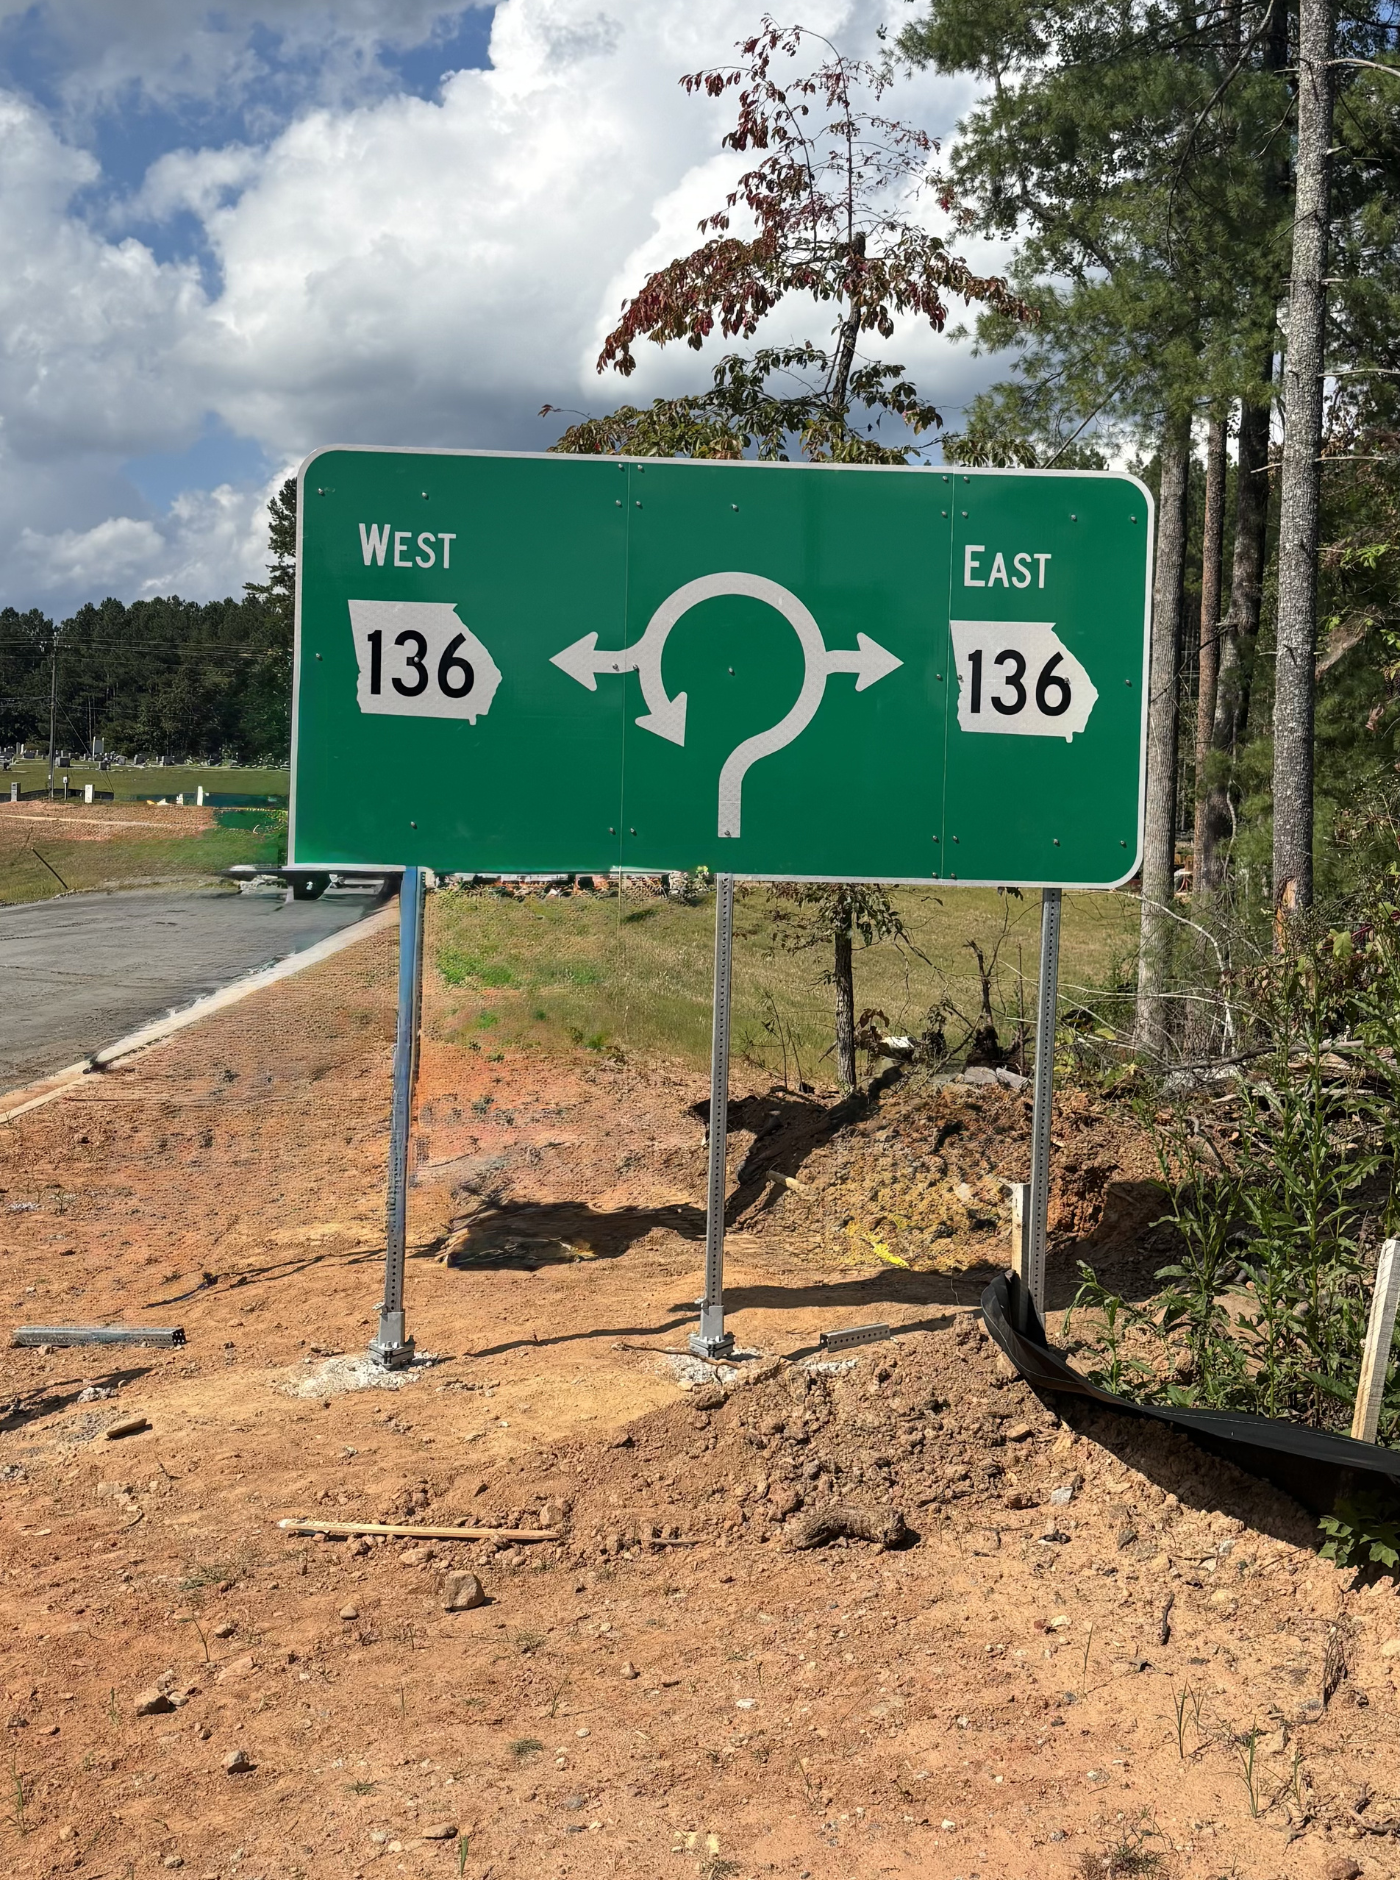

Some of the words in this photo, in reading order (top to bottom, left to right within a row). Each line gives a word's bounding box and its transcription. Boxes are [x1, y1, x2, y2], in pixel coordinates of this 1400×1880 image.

[359, 523, 457, 569] WEST
[963, 545, 1052, 589] EAST
[366, 629, 475, 699] 136
[967, 649, 1072, 717] 136
